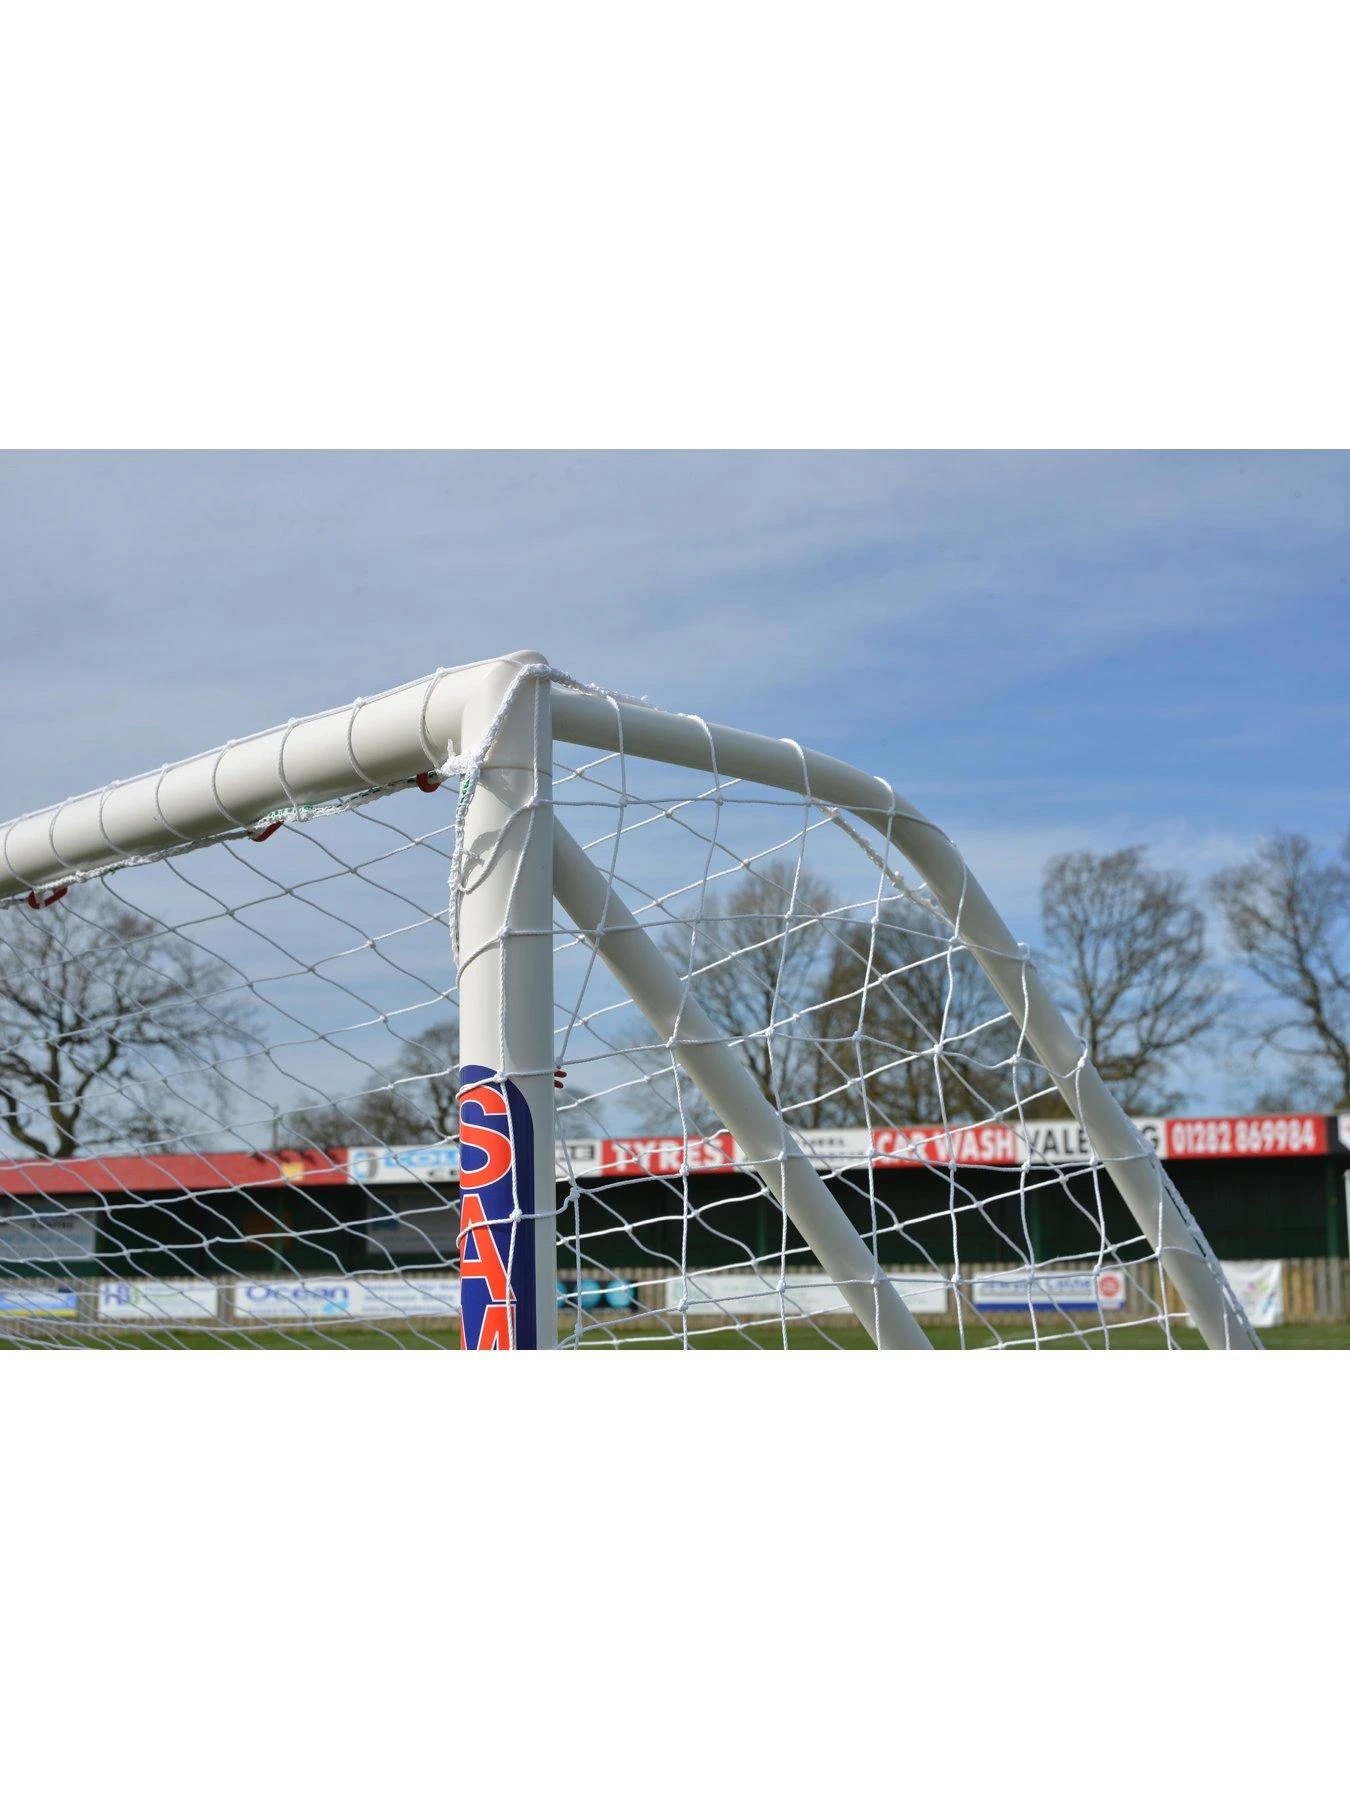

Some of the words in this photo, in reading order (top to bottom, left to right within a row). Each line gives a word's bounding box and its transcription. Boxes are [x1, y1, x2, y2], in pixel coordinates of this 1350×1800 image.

[876, 1130, 934, 1164] CAR
[934, 1125, 1016, 1163] WASH
[1172, 1121, 1231, 1154] 01282
[1235, 1118, 1316, 1153] 869984
[611, 1140, 725, 1172] TYRES
